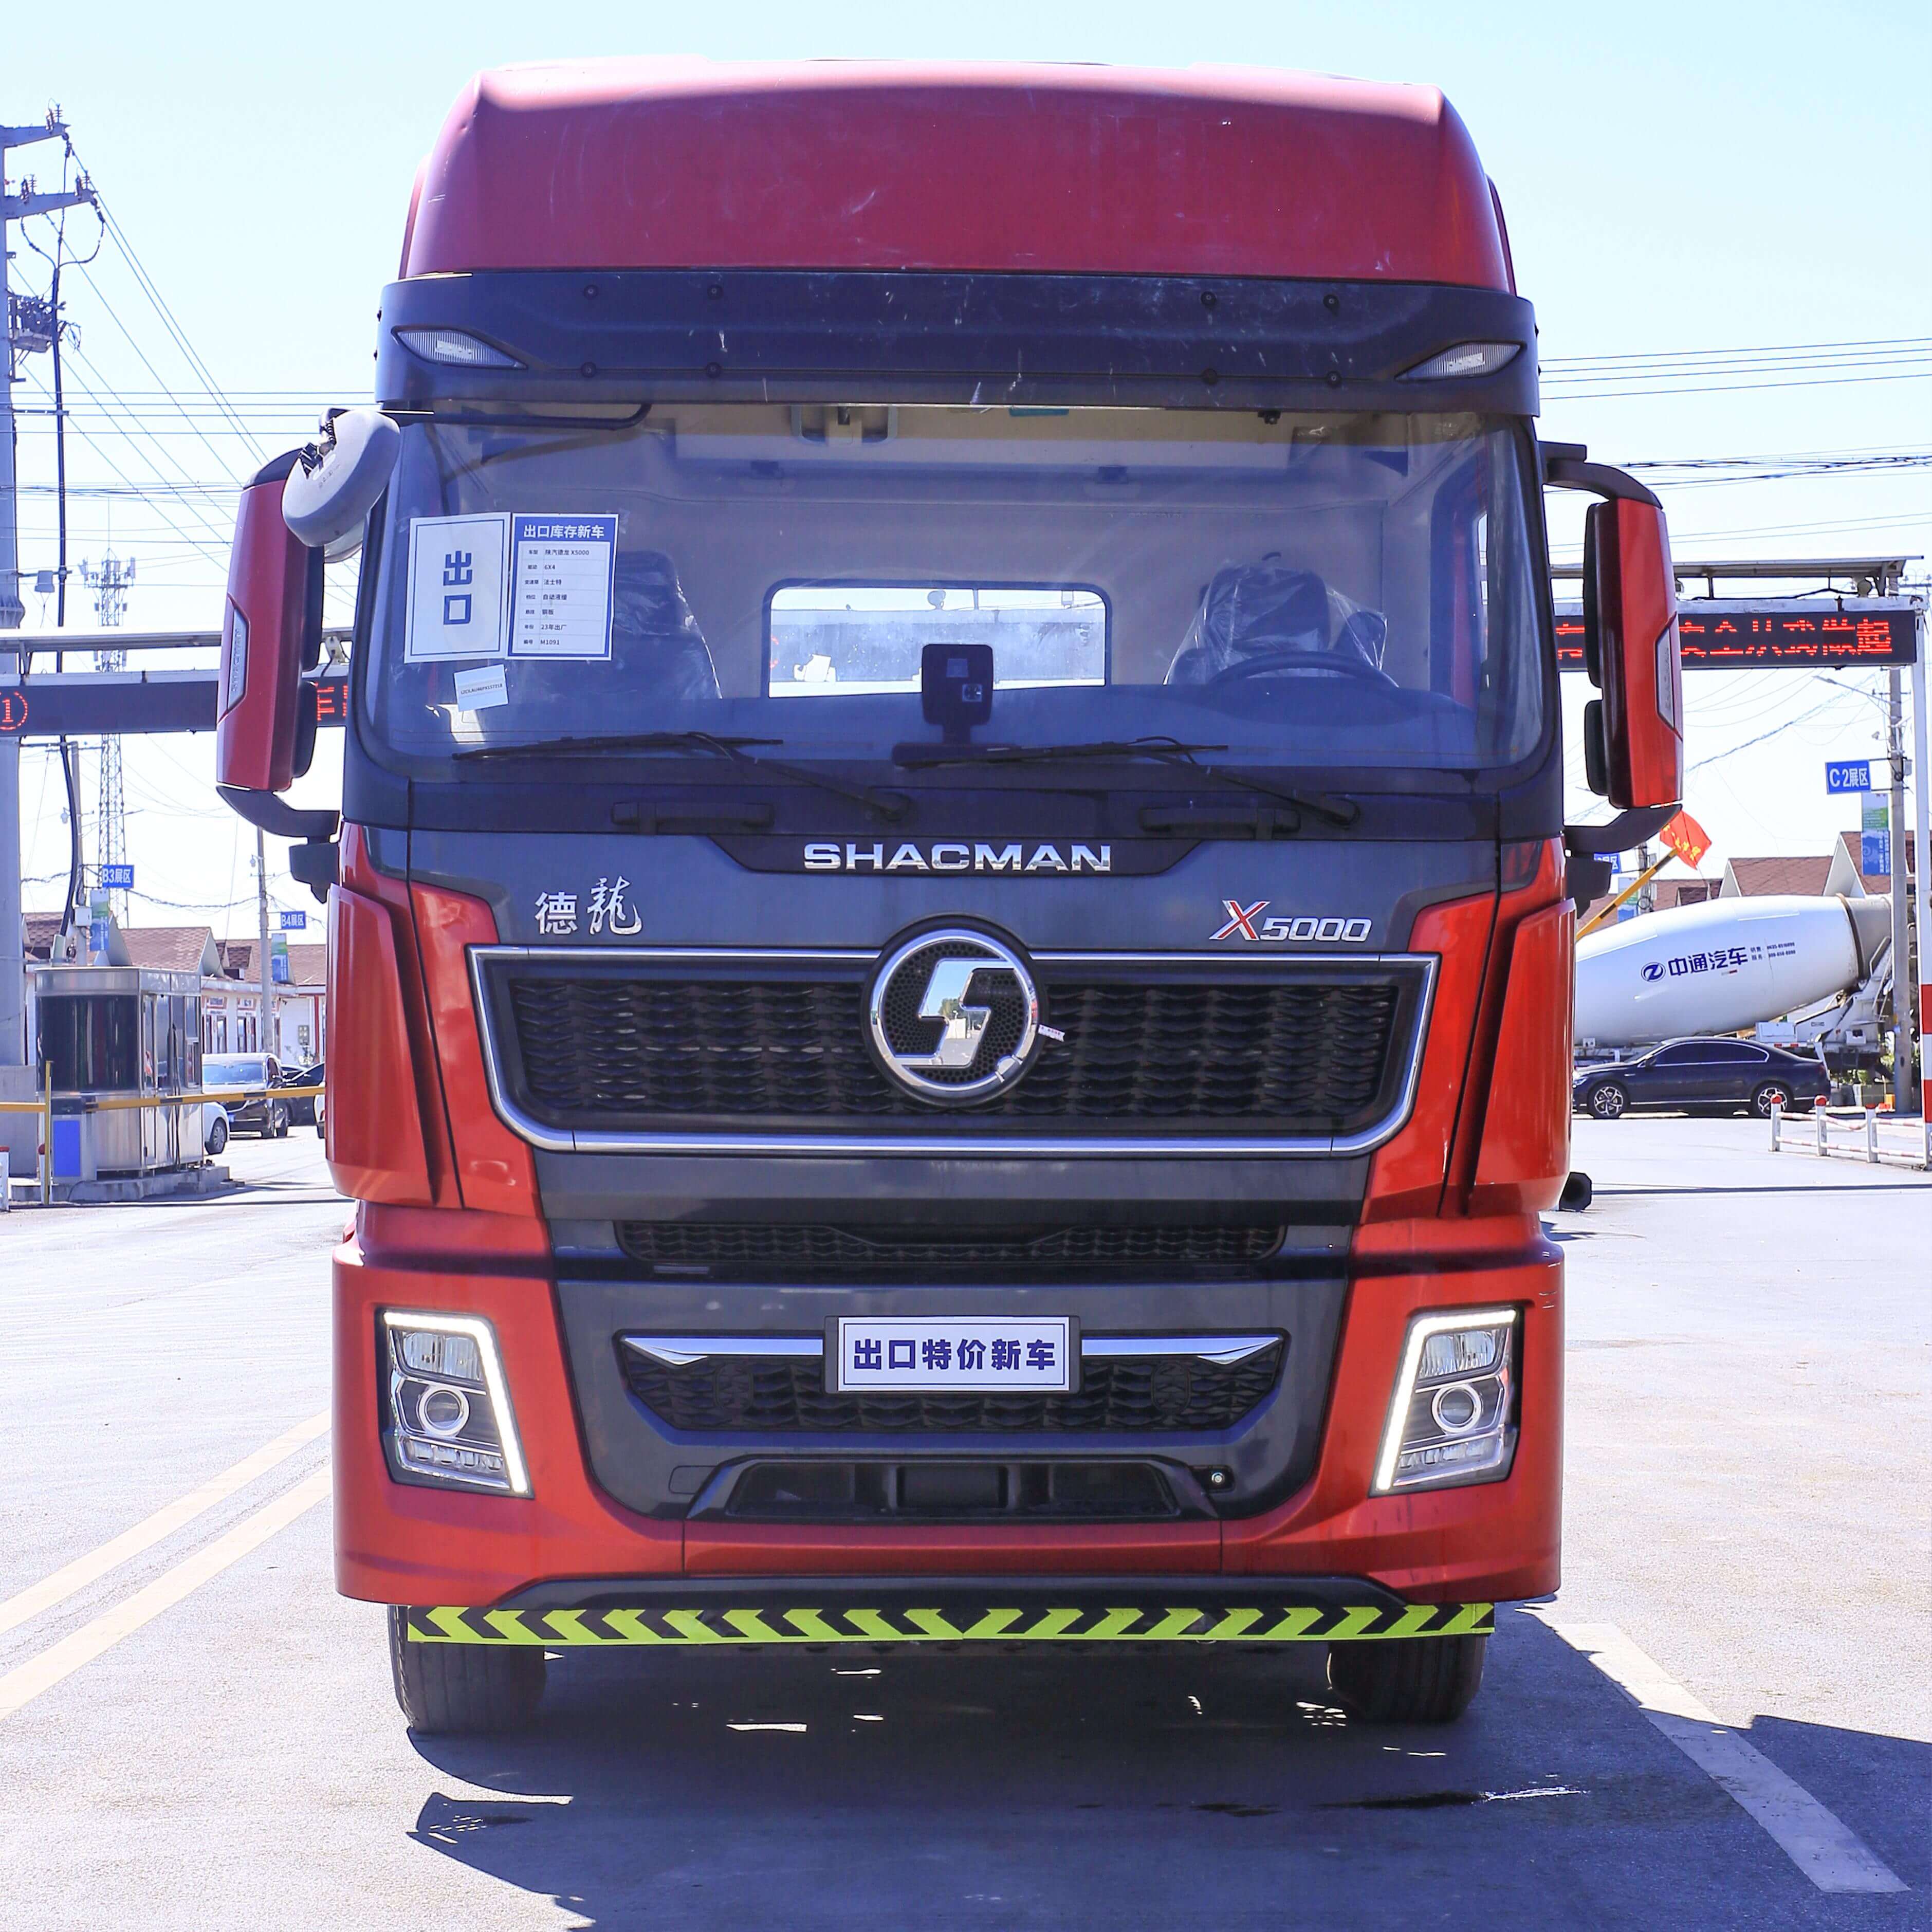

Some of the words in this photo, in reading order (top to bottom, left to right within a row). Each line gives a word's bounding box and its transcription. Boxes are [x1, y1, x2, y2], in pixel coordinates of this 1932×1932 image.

[523, 524, 605, 539] 出口库存新车
[443, 550, 473, 625] 出口
[804, 843, 1111, 872] SHACMAN
[103, 868, 131, 884] B3展区
[281, 914, 305, 927] B4展区
[1208, 899, 1372, 942] X5000
[1668, 947, 1748, 976] 中通汽车
[853, 1338, 1056, 1370] 出口特价新车
